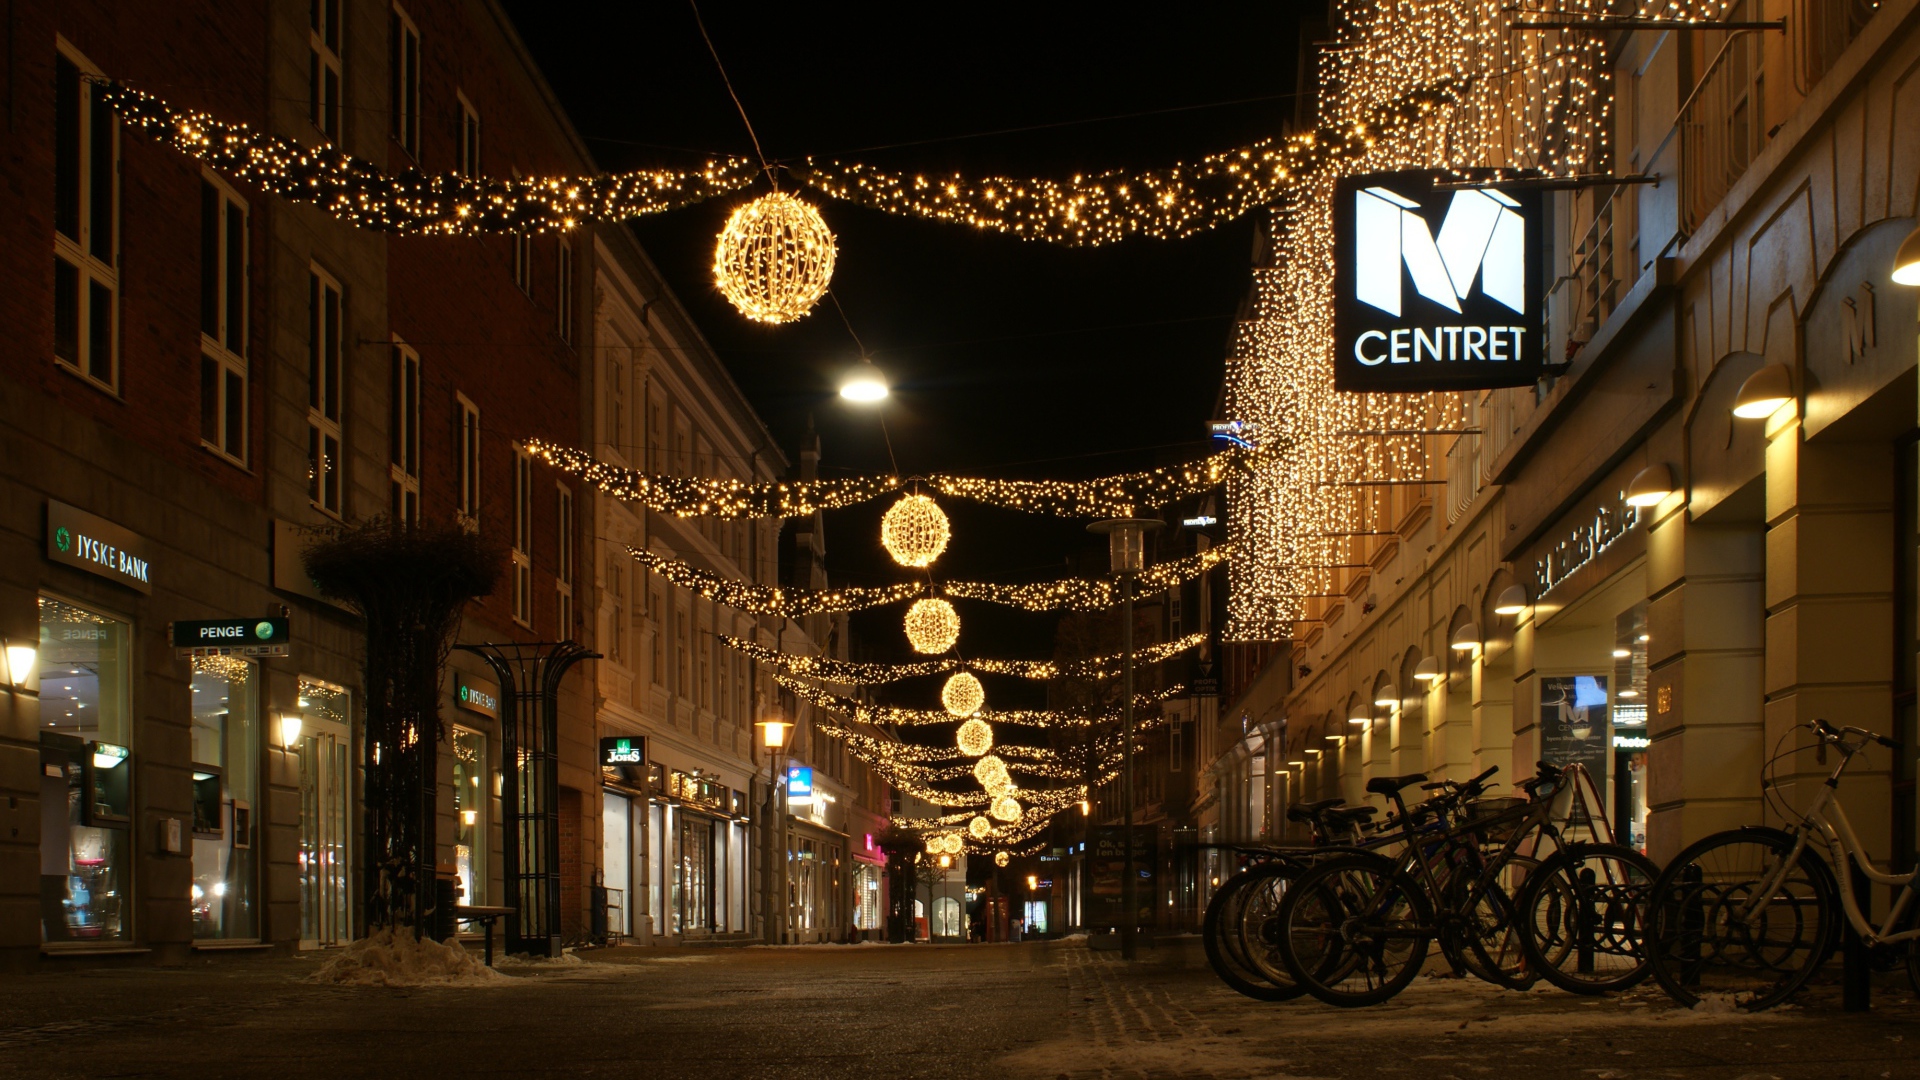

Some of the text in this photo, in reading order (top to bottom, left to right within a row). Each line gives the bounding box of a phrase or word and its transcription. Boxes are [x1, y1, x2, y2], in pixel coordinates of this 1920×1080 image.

[1356, 186, 1525, 318] M
[1354, 326, 1527, 366] CENTRET
[76, 534, 149, 583] JYSKE BANK
[200, 625, 244, 639] PENGE
[469, 688, 485, 707] JYSKE
